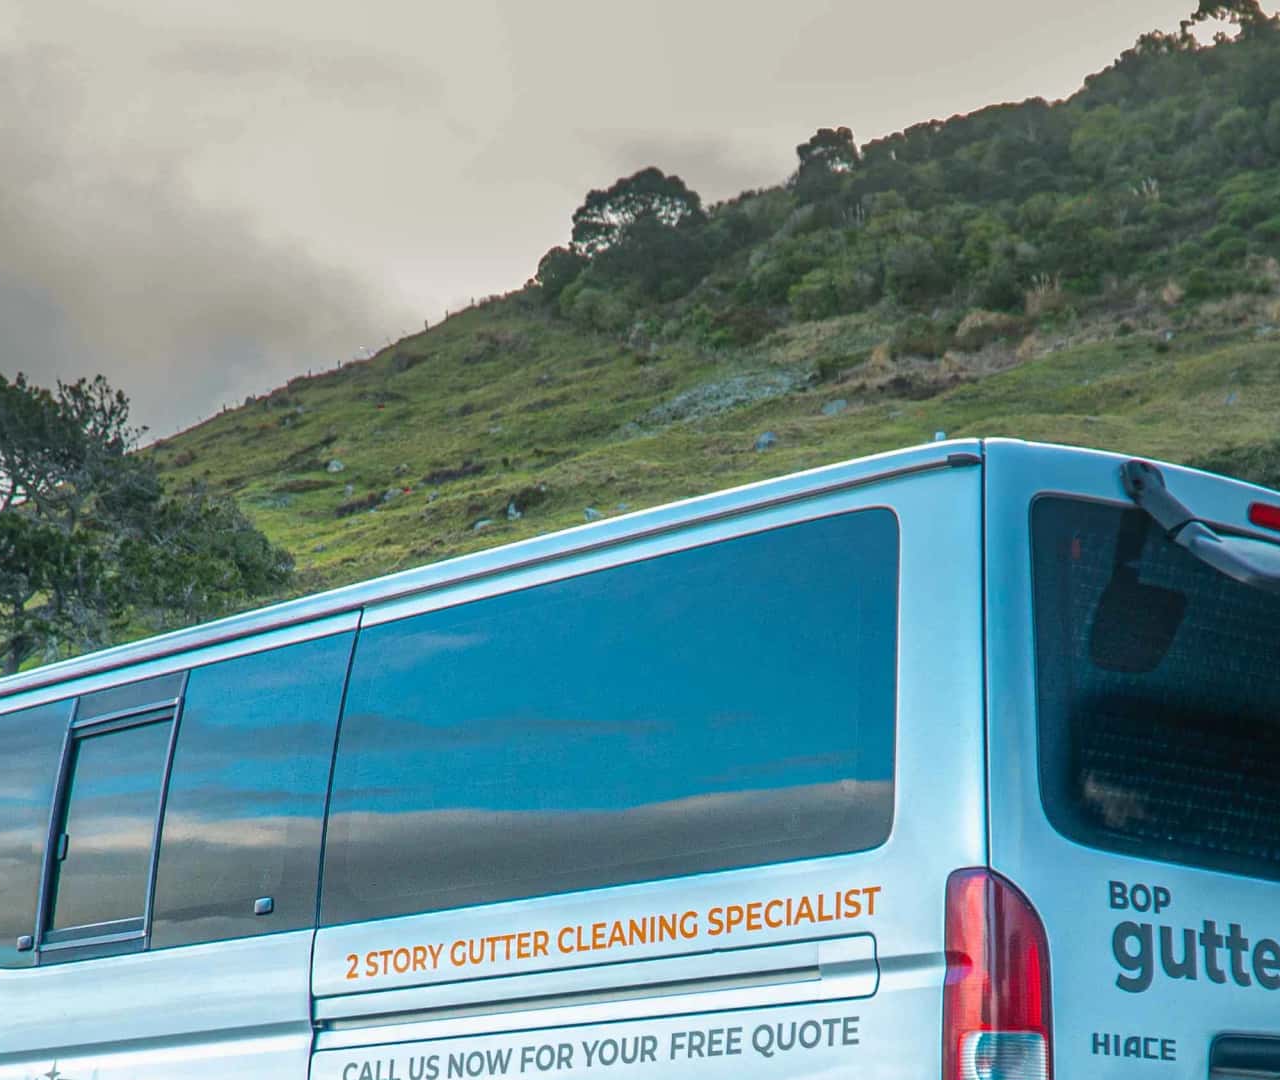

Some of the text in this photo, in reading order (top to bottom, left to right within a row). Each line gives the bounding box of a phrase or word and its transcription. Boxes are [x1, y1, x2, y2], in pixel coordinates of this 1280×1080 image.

[1109, 880, 1171, 914] BOP
[346, 886, 881, 979] 2 STORY GUTTER CLEANING SPECIALIST
[448, 1048, 512, 1079] NOW
[520, 1042, 574, 1073] FOR
[582, 1035, 657, 1068] YOUR
[670, 1026, 742, 1060] FREE
[751, 1016, 860, 1058] QUOTE
[1091, 1032, 1176, 1060] HIACE
